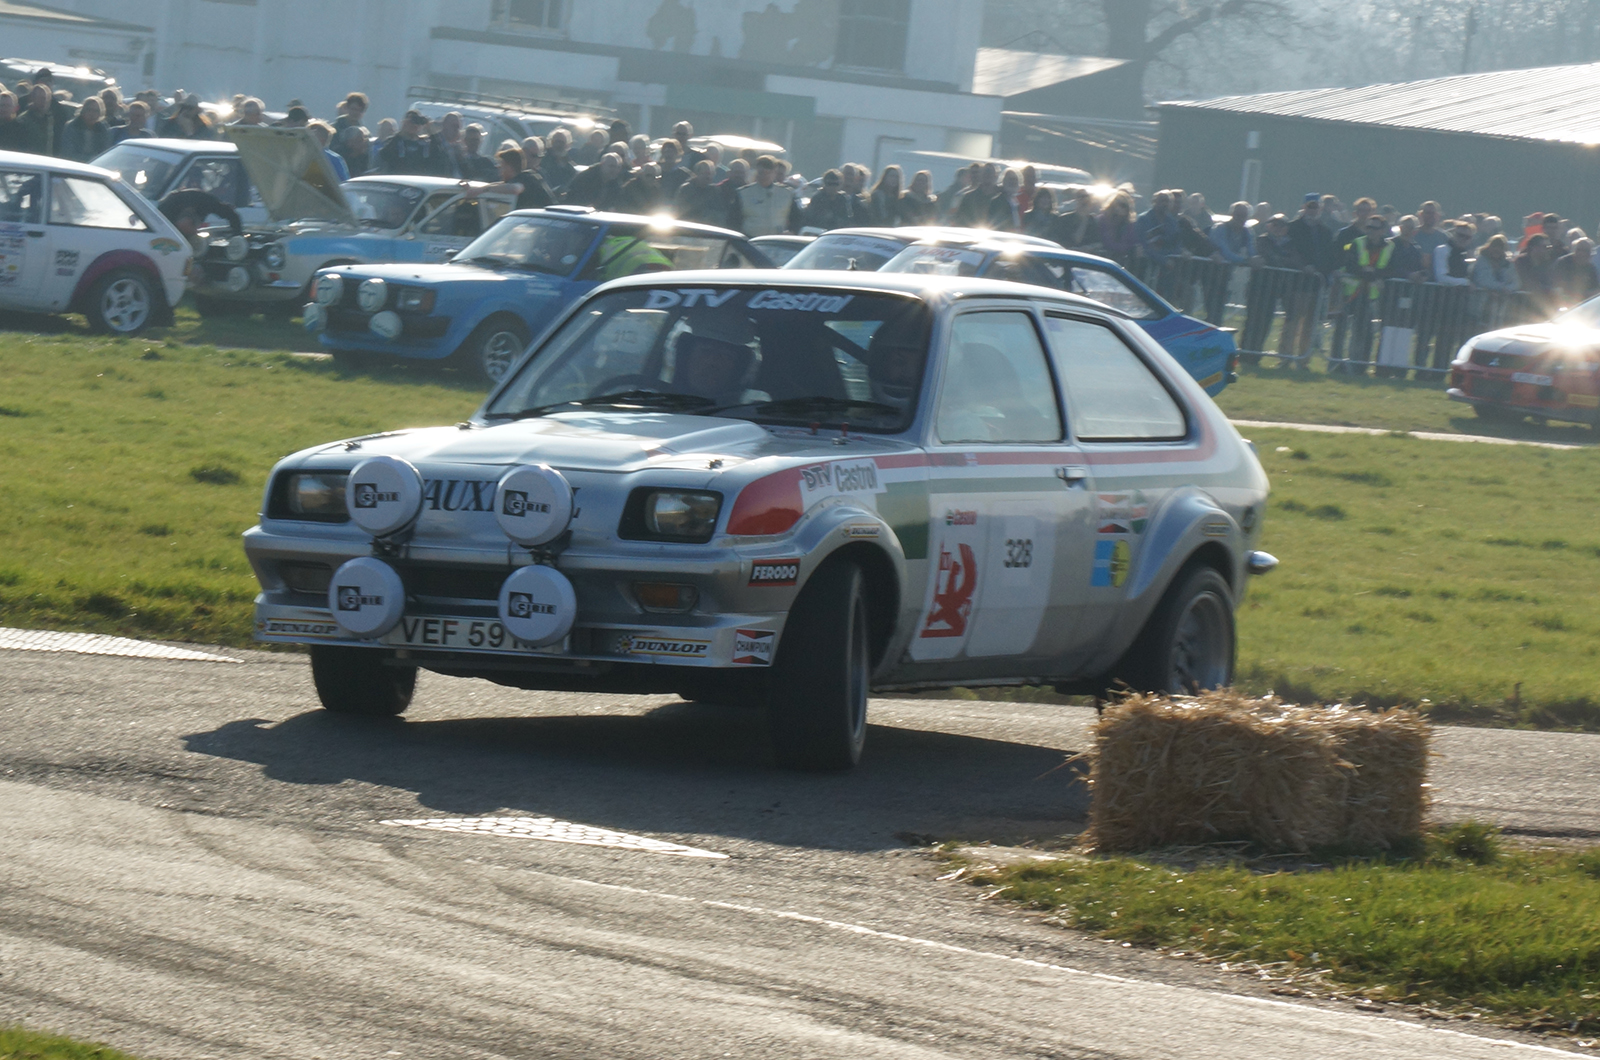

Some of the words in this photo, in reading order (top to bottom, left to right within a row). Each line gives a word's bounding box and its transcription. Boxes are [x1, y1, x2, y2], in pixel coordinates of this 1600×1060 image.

[644, 288, 740, 309] DTV
[746, 289, 855, 313] Castrol
[801, 463, 832, 492] DTV
[833, 462, 878, 493] Castrol
[752, 565, 798, 580] FERODO
[268, 622, 339, 634] DUNLOP
[402, 618, 459, 644] VEF
[634, 640, 708, 654] DUNLOP
[736, 640, 773, 653] CHAMPION
